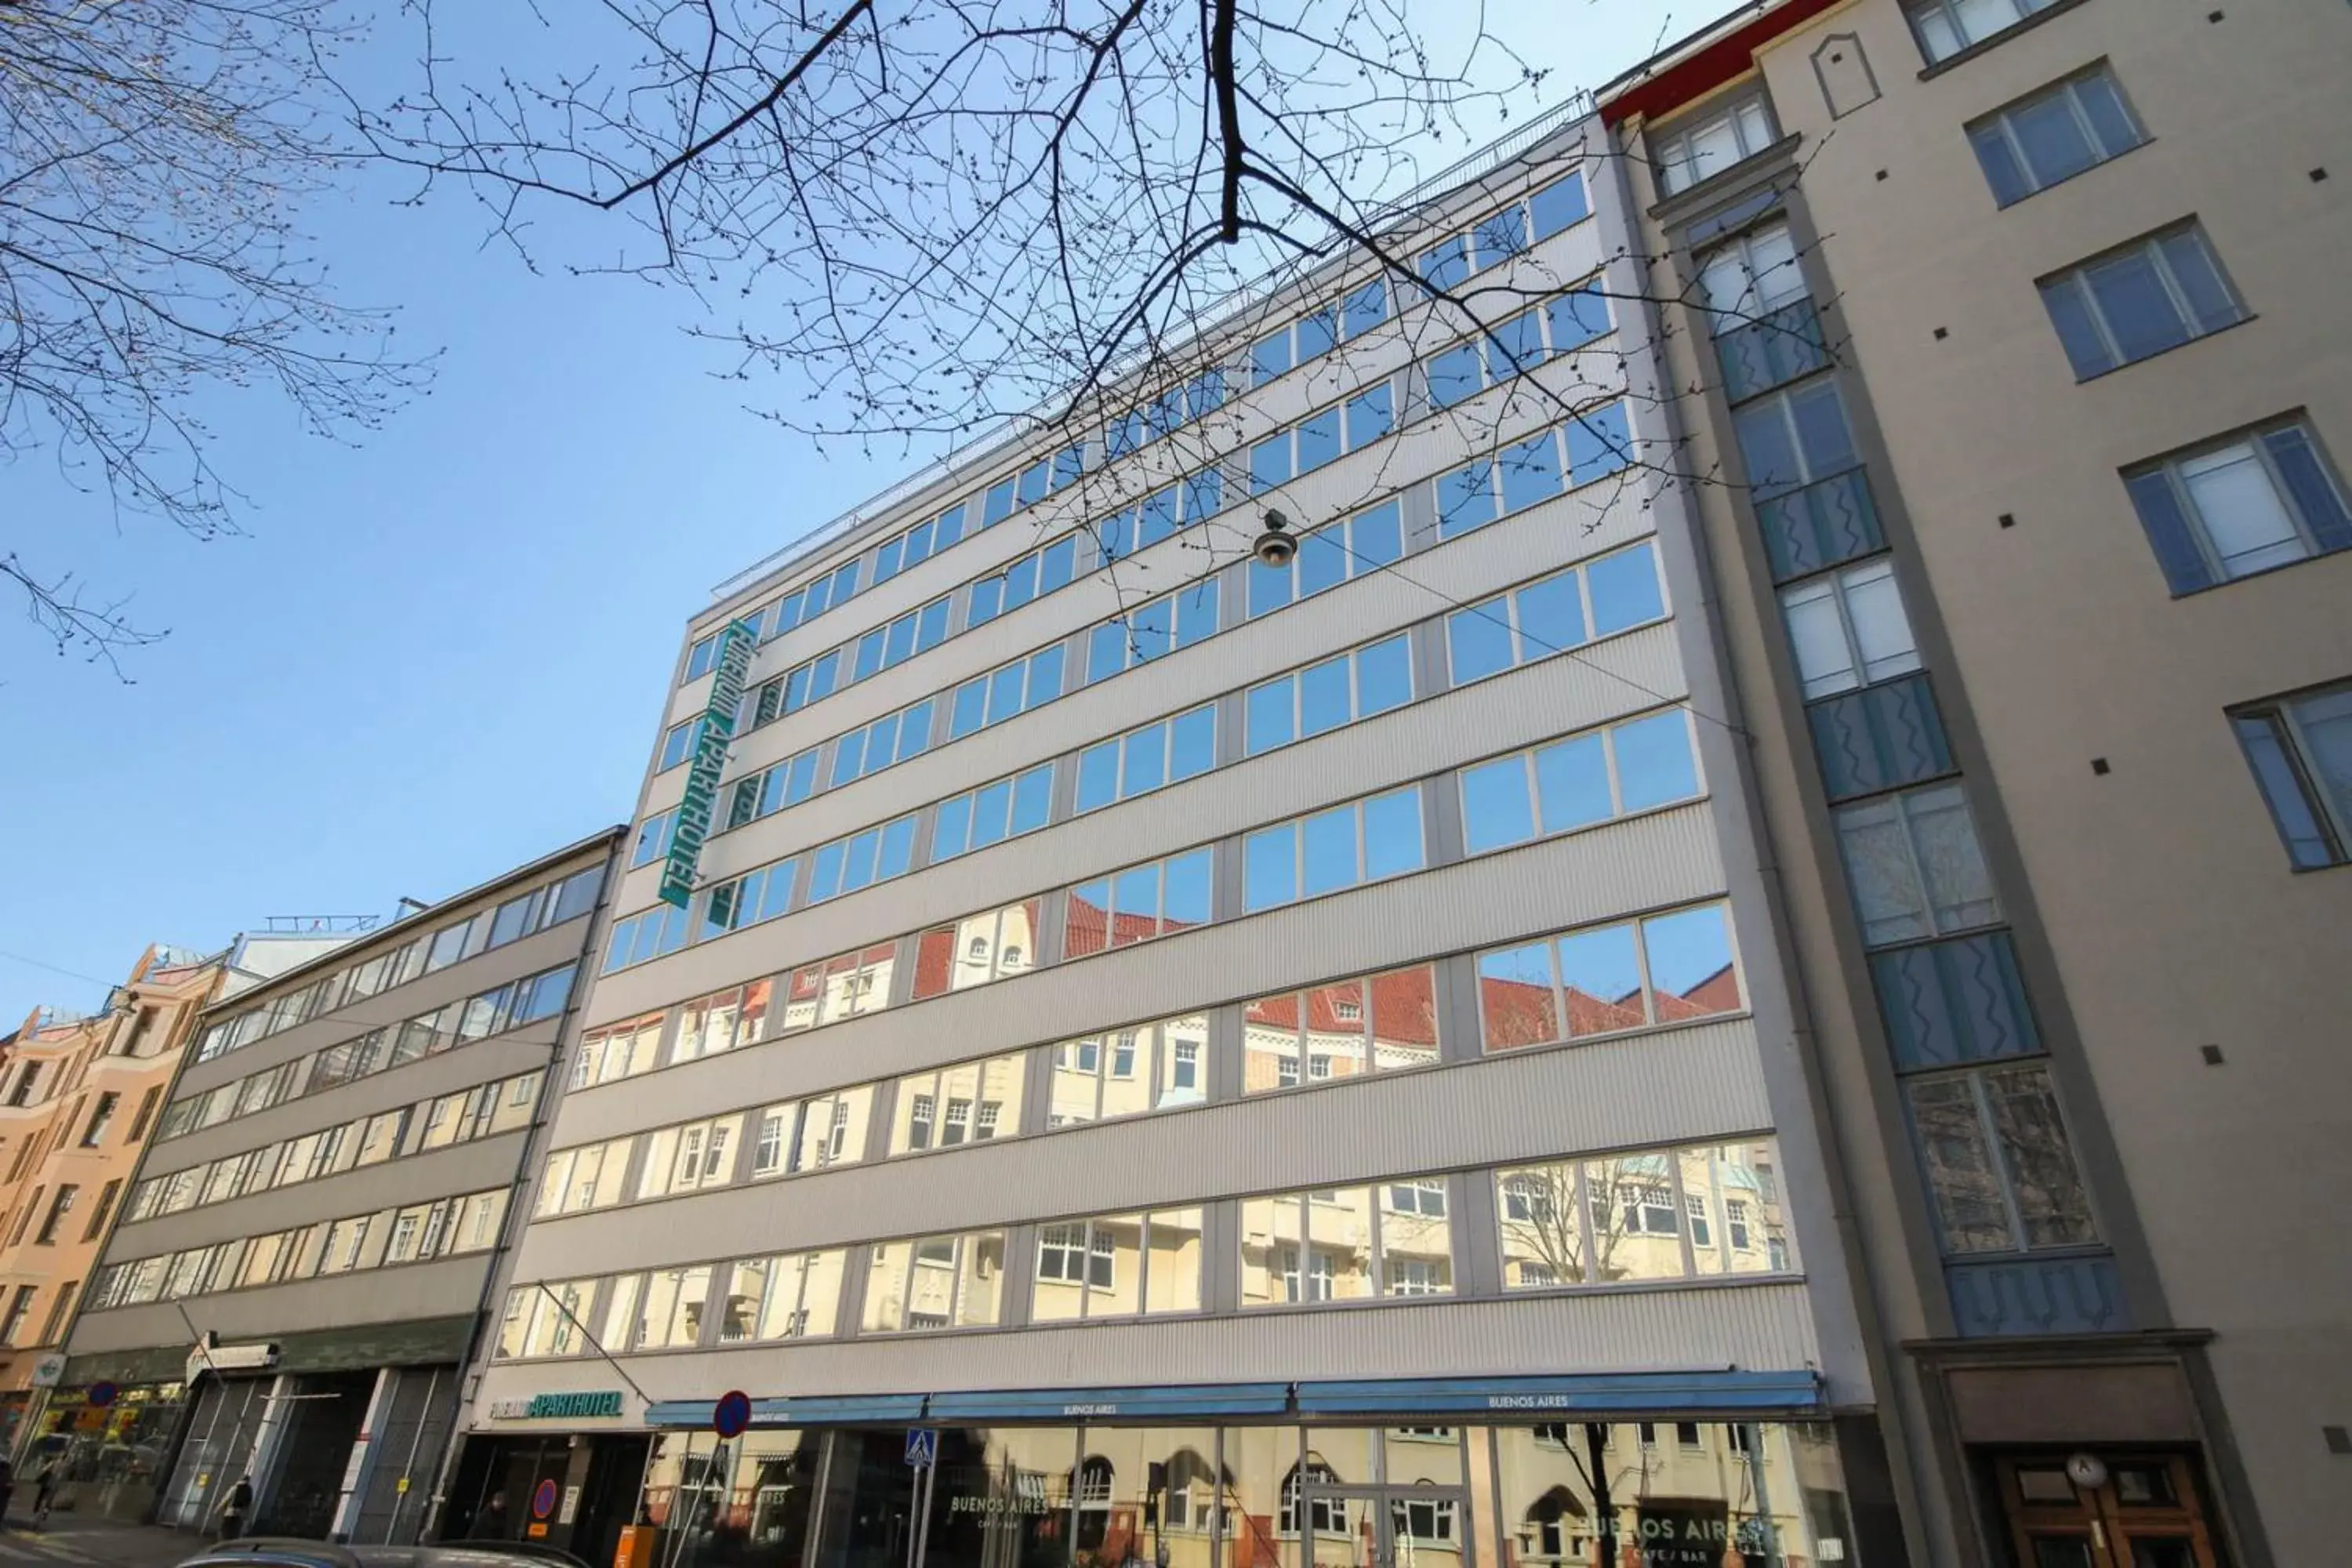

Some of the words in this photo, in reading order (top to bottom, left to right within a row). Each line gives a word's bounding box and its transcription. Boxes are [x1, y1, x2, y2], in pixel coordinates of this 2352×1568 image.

[664, 717, 732, 890] APARTHOTEL
[528, 1391, 624, 1417] APARTHOTEL
[1489, 1395, 1534, 1408] BUENOS
[1537, 1395, 1568, 1408] AIRES
[2078, 1457, 2092, 1473] A
[951, 1496, 1005, 1512] BUENOS
[1009, 1497, 1049, 1515] AIRES
[1680, 1550, 1707, 1563] BAR
